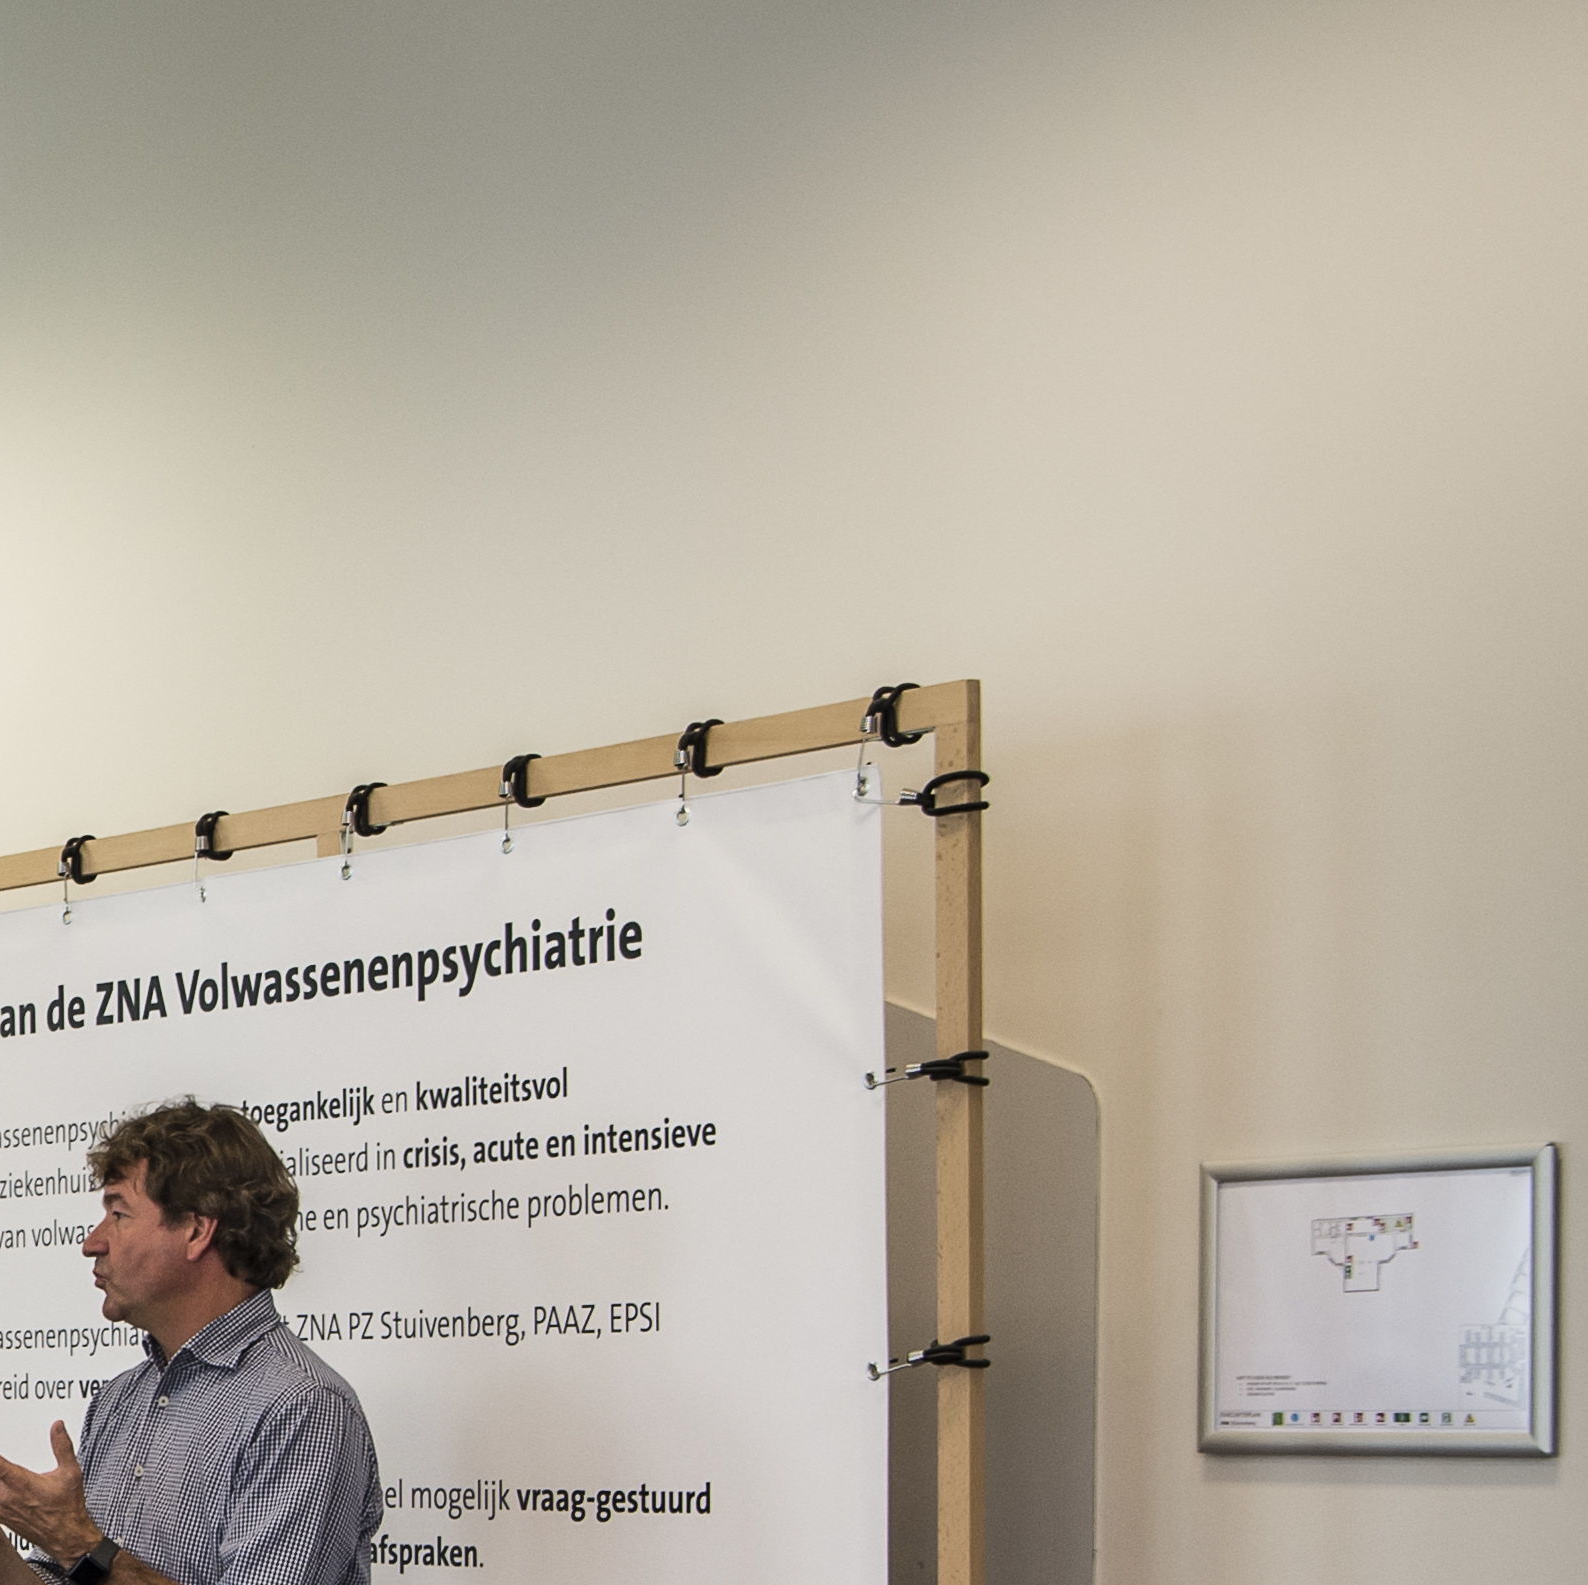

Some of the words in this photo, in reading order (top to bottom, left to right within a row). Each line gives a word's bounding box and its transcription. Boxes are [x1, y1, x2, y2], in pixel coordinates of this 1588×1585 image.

[47, 985, 85, 1032] de
[95, 975, 167, 1026] ZNA
[175, 907, 643, 1015] Volwassenenpsychiatrie
[381, 1092, 408, 1114] en
[416, 1067, 568, 1112] kwaliteitsvol
[280, 1143, 368, 1177] aliseerd
[376, 1143, 395, 1171] in
[402, 1136, 466, 1171] crisis,
[473, 1132, 539, 1165] acute
[546, 1128, 575, 1159] en
[583, 1117, 717, 1155] intensieve
[31, 1219, 94, 1247] volwas
[323, 1205, 349, 1230] en
[356, 1190, 520, 1237] psychiatrische
[527, 1184, 669, 1228] problemen.
[296, 1312, 342, 1342] ZNA
[348, 1312, 374, 1340] PZ
[380, 1306, 525, 1345] Stuivenberg,
[533, 1304, 602, 1340] PAAZ,
[610, 1302, 661, 1333] EPSI
[35, 1379, 73, 1399] over
[411, 1479, 510, 1520] mogelijk
[516, 1482, 711, 1522] vraag-gestuurd
